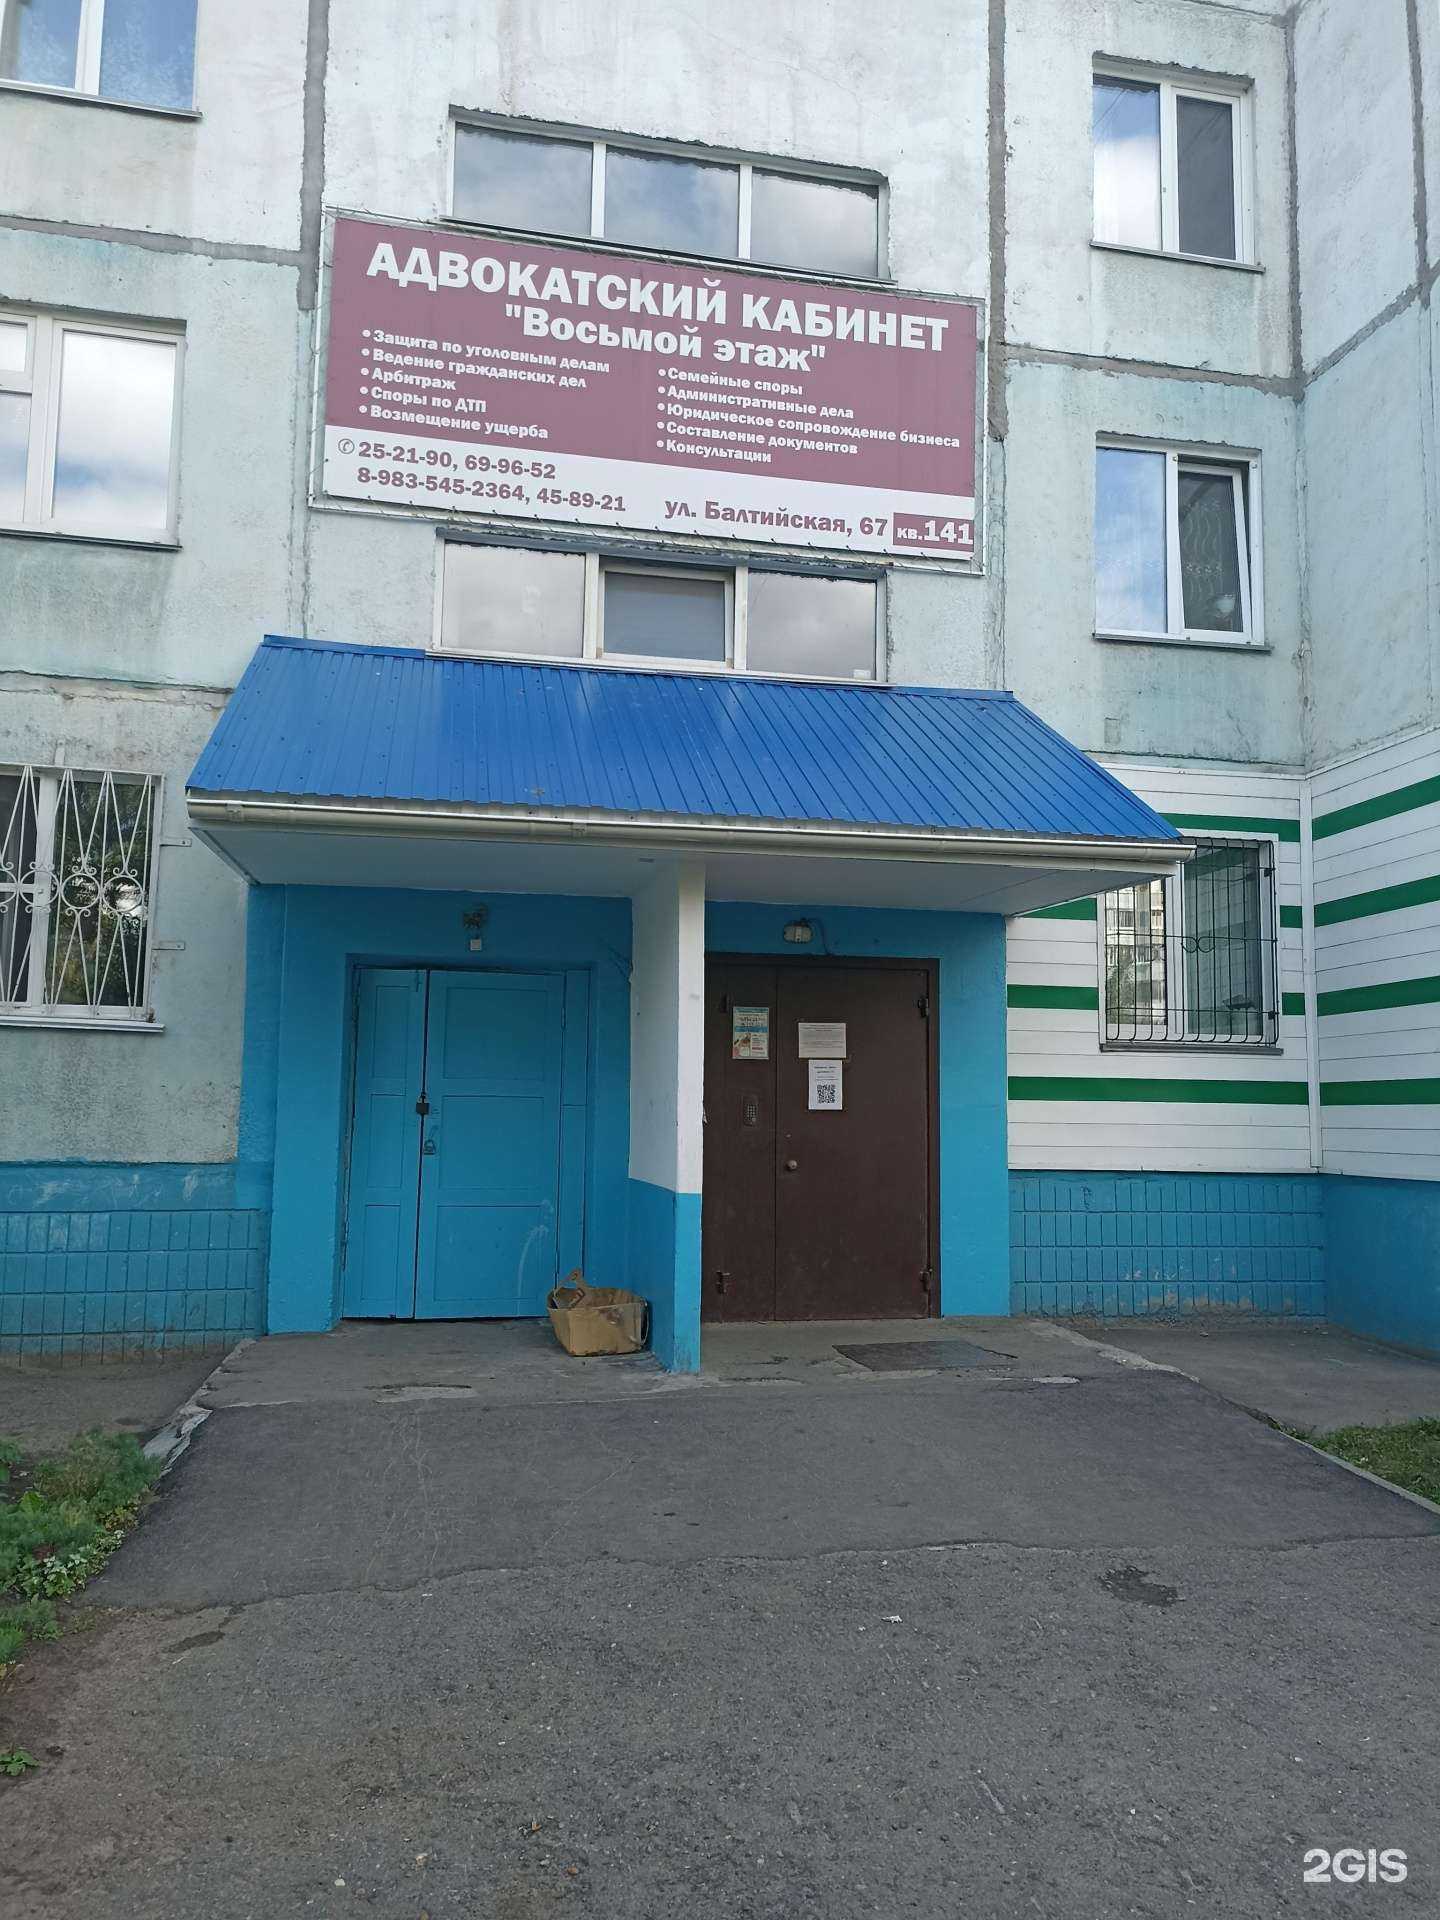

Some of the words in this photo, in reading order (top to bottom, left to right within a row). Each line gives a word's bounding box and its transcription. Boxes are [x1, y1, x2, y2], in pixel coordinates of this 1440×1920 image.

[366, 242, 727, 324] АДВОКАТСКИЙ
[742, 294, 949, 352] КАБИНЕТ
[373, 329, 438, 351] Защита
[442, 340, 462, 354] по
[466, 344, 557, 367] уголовным
[559, 357, 610, 372] делам
[505, 303, 702, 358] "Восьмой
[713, 336, 826, 372] этаж"
[372, 368, 456, 391] Арбитраж
[373, 348, 444, 370] Ведение
[448, 361, 555, 385] гражданских
[559, 375, 588, 388] дел
[667, 367, 751, 389] Семейные
[754, 380, 803, 396] споры
[371, 386, 427, 406] Споры
[431, 396, 451, 409] по
[455, 398, 487, 413] ДТП
[667, 385, 817, 414] Административные
[820, 406, 854, 419] дела
[370, 405, 481, 431] Возмещение
[485, 420, 549, 439] ущерба
[667, 403, 774, 427] Юридическое
[778, 418, 897, 441] сопровождение
[899, 430, 960, 448] бизнеса
[667, 422, 765, 444] Составление
[768, 435, 858, 454] документов
[358, 442, 458, 471] 25-21-90,
[465, 454, 556, 480] 69-96-52
[666, 439, 772, 463] Консультации
[357, 467, 530, 504] 8-983-545-2364,
[537, 488, 626, 512] 45-89-21
[665, 499, 697, 519] ул.
[705, 500, 852, 537] Балтийская,
[859, 516, 888, 536] 67
